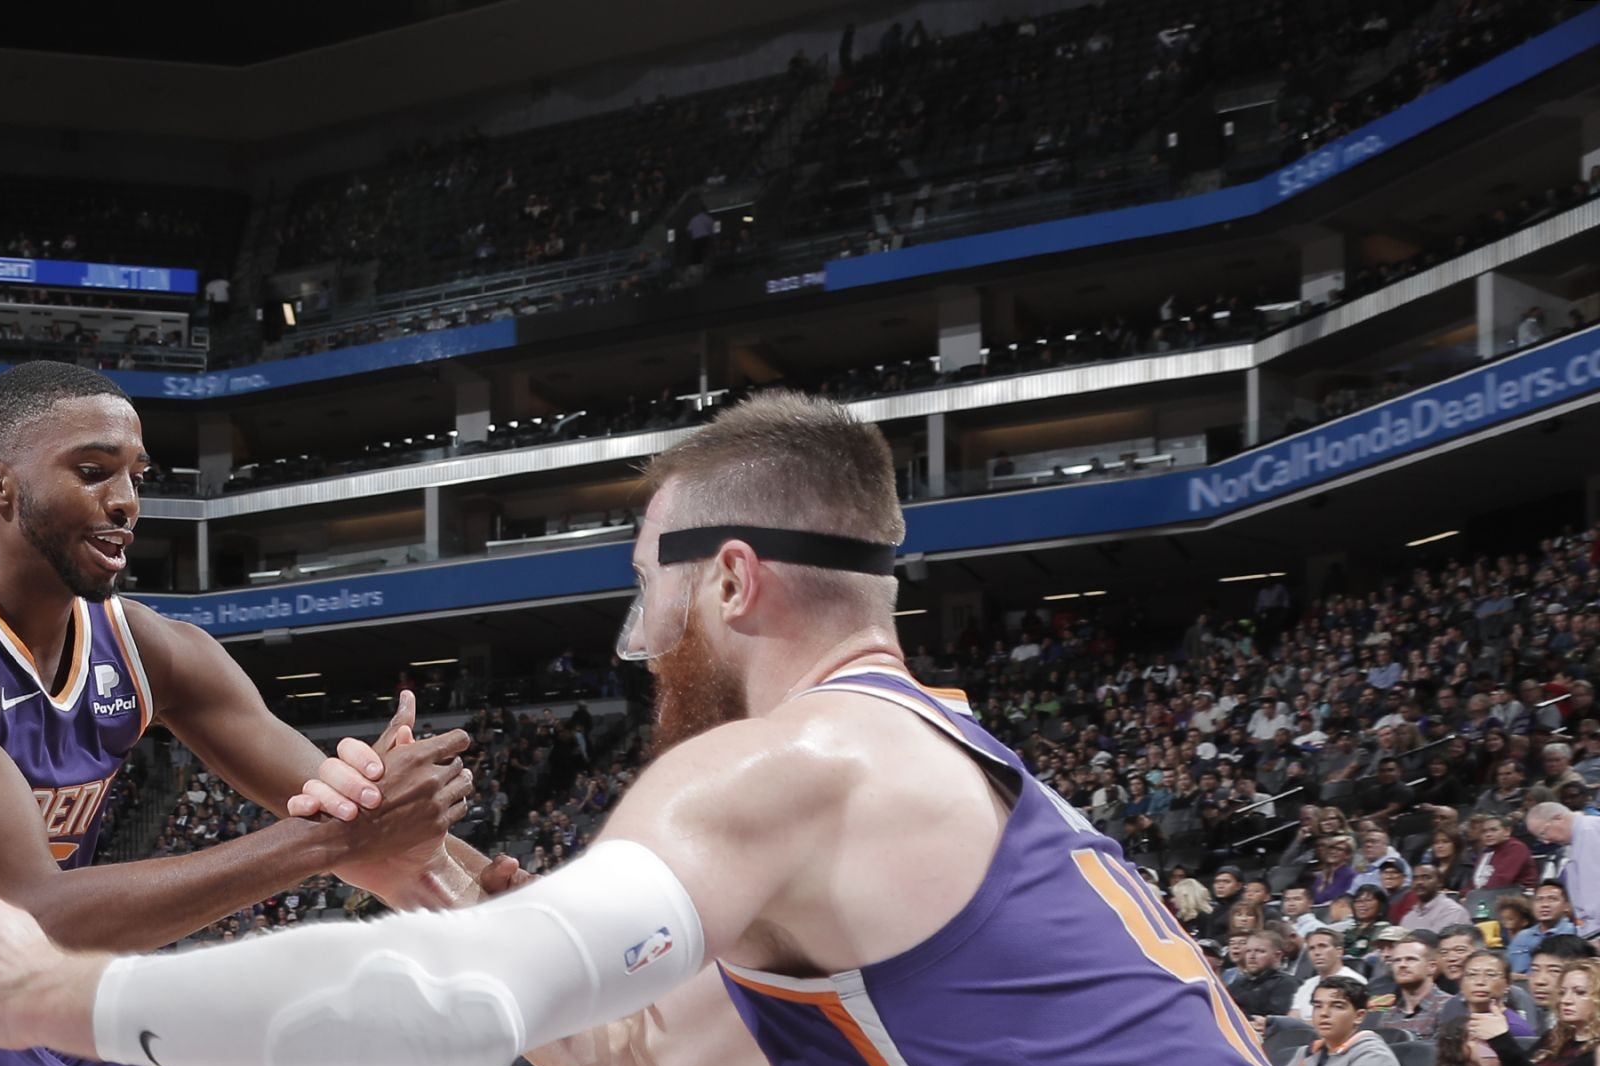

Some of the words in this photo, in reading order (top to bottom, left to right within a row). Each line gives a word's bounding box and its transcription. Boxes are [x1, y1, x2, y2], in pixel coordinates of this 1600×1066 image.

[218, 596, 293, 625] Honda
[296, 589, 384, 615] Dealers
[93, 696, 136, 715] PayPal
